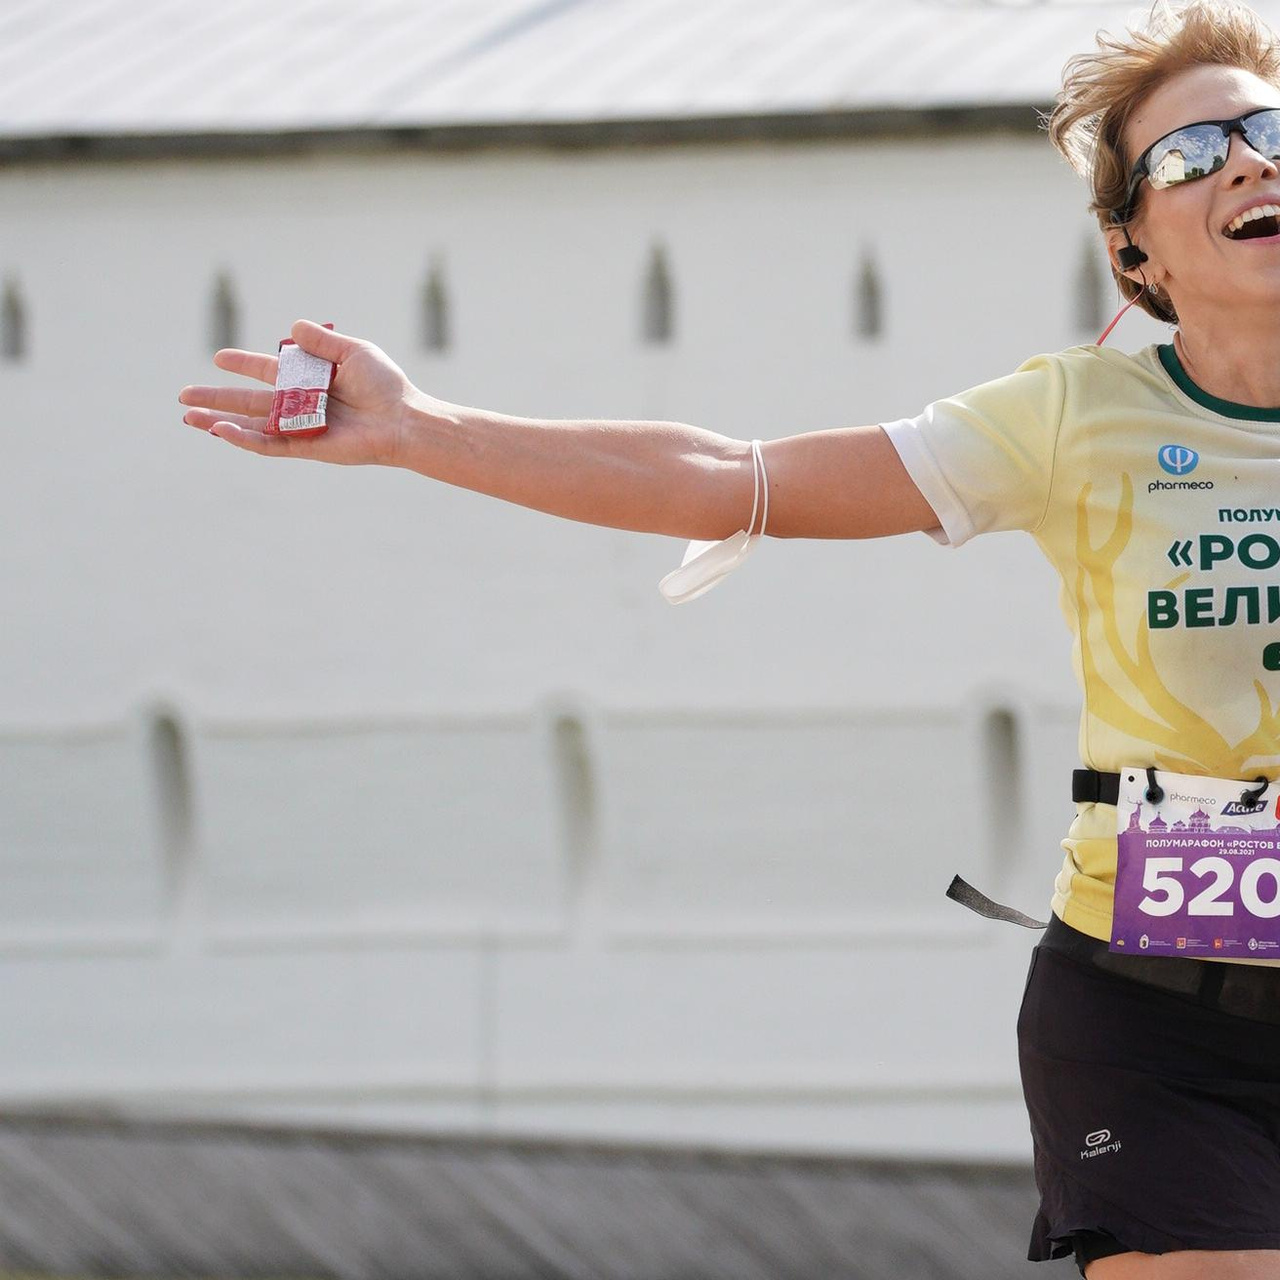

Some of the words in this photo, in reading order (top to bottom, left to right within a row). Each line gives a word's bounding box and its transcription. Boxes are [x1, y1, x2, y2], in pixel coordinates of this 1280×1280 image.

[1147, 480, 1214, 494] pharmeco
[1169, 792, 1217, 806] pharmeco
[1145, 839, 1225, 848] ПОЛУМАРАФОН
[1226, 840, 1274, 850] «РОСТОВ
[1218, 848, 1255, 856] 29.08.2021
